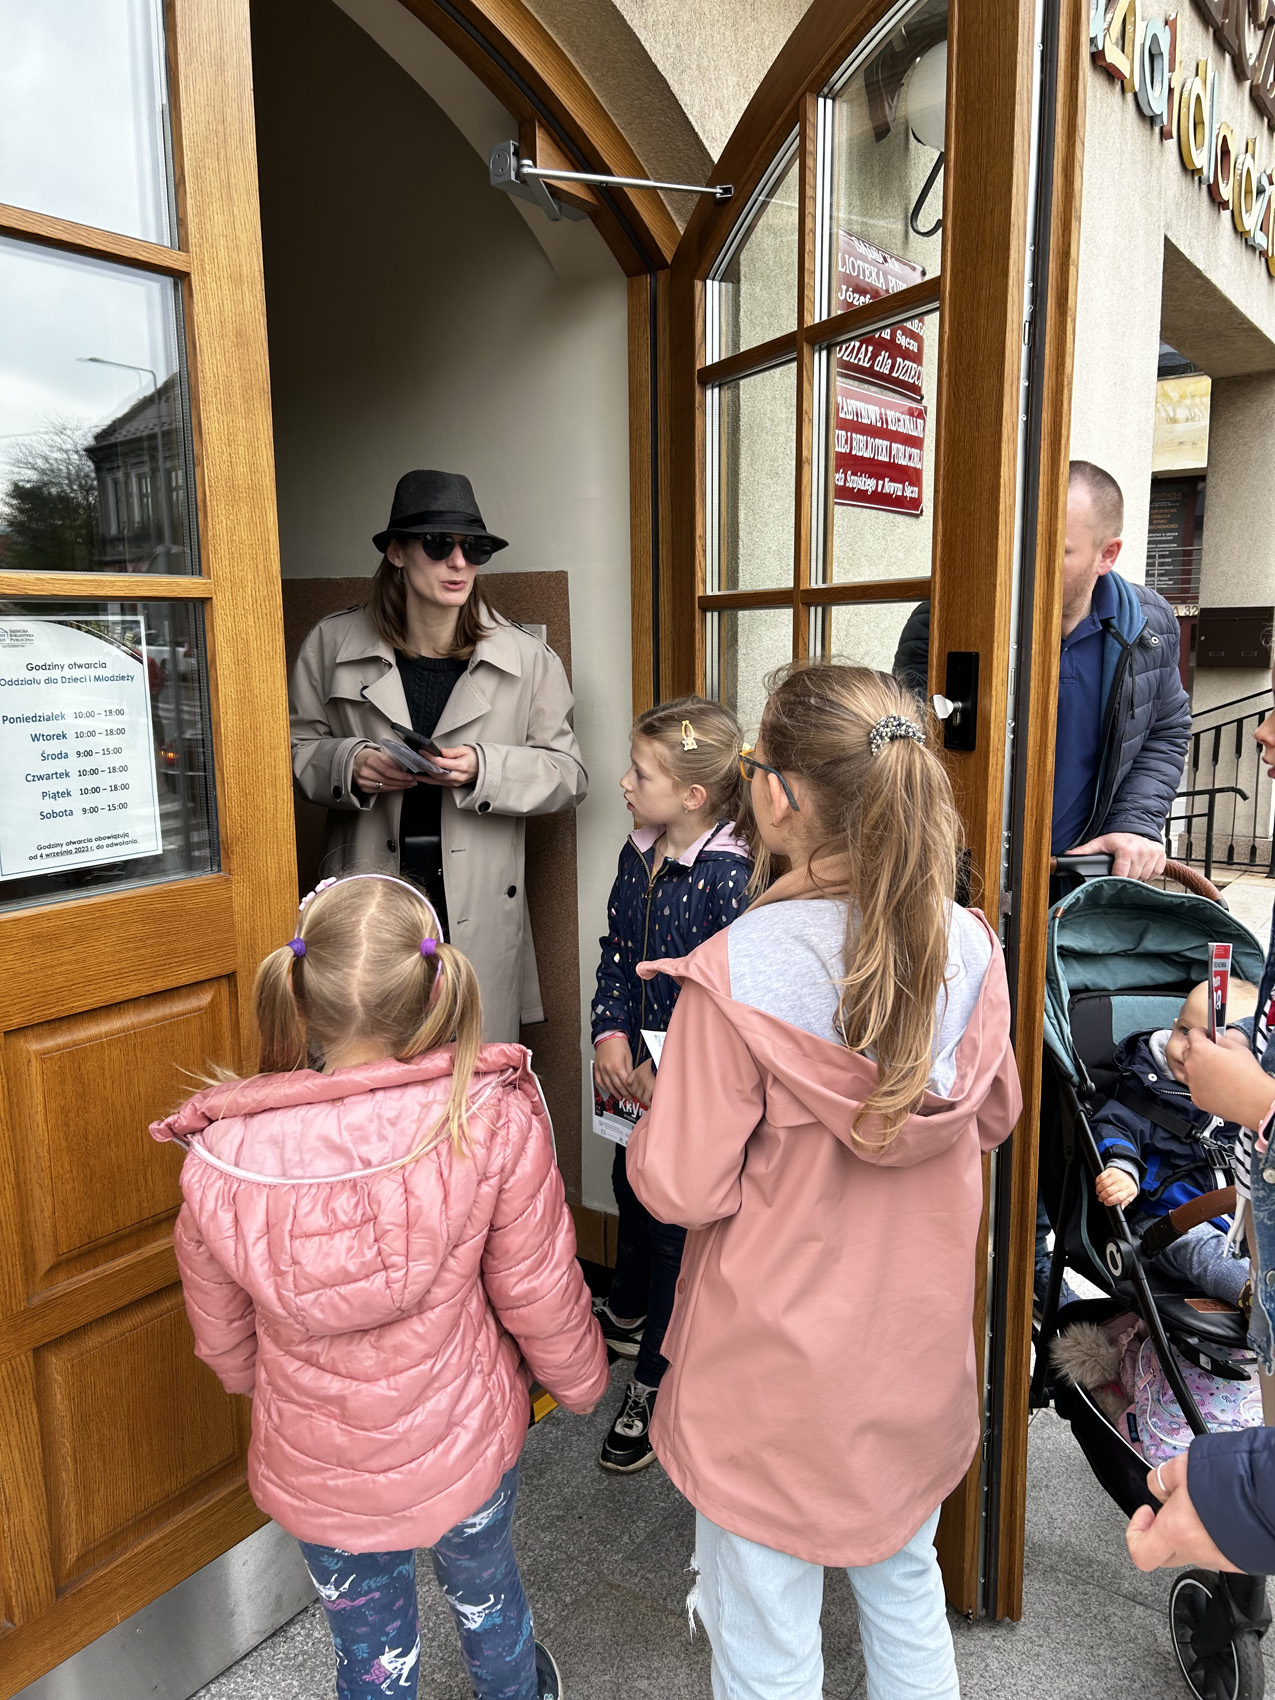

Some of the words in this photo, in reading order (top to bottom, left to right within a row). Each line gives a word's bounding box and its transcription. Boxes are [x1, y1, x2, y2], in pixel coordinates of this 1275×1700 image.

[838, 284, 873, 306] Józef
[896, 329, 918, 353] Sączu
[874, 350, 892, 374] dla
[851, 432, 890, 462] BIBLIOTEKI
[834, 468, 845, 486] efa
[845, 470, 877, 495] Szujskiego
[883, 477, 903, 498] Nowym
[903, 481, 919, 500] Sączu
[1184, 604, 1199, 616] 32
[26, 662, 65, 672] Godziny
[68, 660, 107, 670] otwarcia
[0, 676, 41, 687] Oddziału
[44, 676, 58, 685] dla
[61, 674, 87, 684] Dzieci
[93, 673, 135, 683] Młodzieży
[2, 711, 66, 725] Poniedziałek
[73, 710, 95, 719] 10:00
[103, 708, 125, 717] 18:00
[30, 730, 68, 743] Wtorek
[74, 730, 96, 739] 10:00
[105, 728, 126, 737] 18:00
[40, 749, 69, 762] Środa
[76, 749, 93, 758] 9:00
[101, 746, 123, 756] 15:00
[25, 768, 71, 783] Czwartek
[77, 768, 99, 777] 10:00
[107, 765, 128, 774] 18:00
[41, 788, 72, 801] Piątek
[79, 786, 101, 796] 10:00
[109, 783, 130, 792] 18:00
[39, 808, 74, 821] Sobota
[81, 805, 99, 815] 9:00
[107, 802, 128, 812] 15:00
[28, 853, 38, 861] od
[45, 848, 73, 858] września
[74, 846, 89, 854] 2023
[105, 838, 139, 849] odwołania.
[37, 841, 64, 851] Godziny
[65, 837, 93, 847] otwarcia
[94, 832, 130, 842] obowiązują
